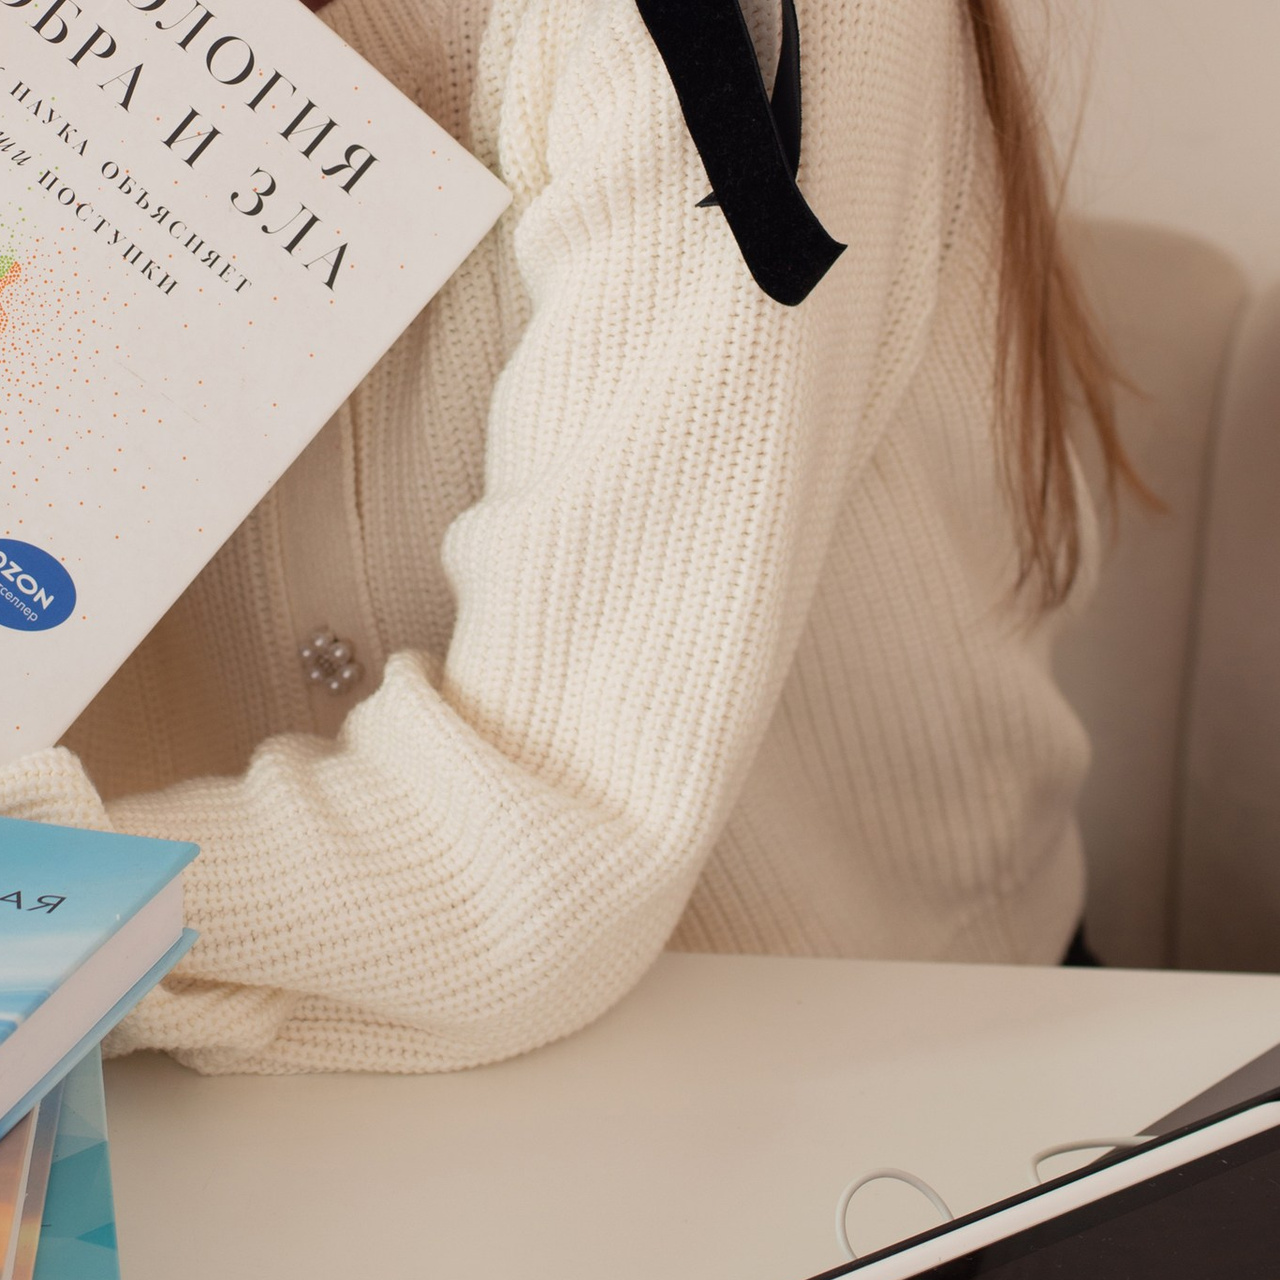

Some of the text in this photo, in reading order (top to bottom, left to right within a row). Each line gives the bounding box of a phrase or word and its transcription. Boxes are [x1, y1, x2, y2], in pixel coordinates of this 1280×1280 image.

[9, 80, 89, 157] НАУКА
[100, 160, 253, 293] ОБЪЯСНЯЕТ
[35, 170, 180, 296] ПОСТУПКИ
[161, 106, 223, 170] И
[230, 166, 354, 292] ЗЛА
